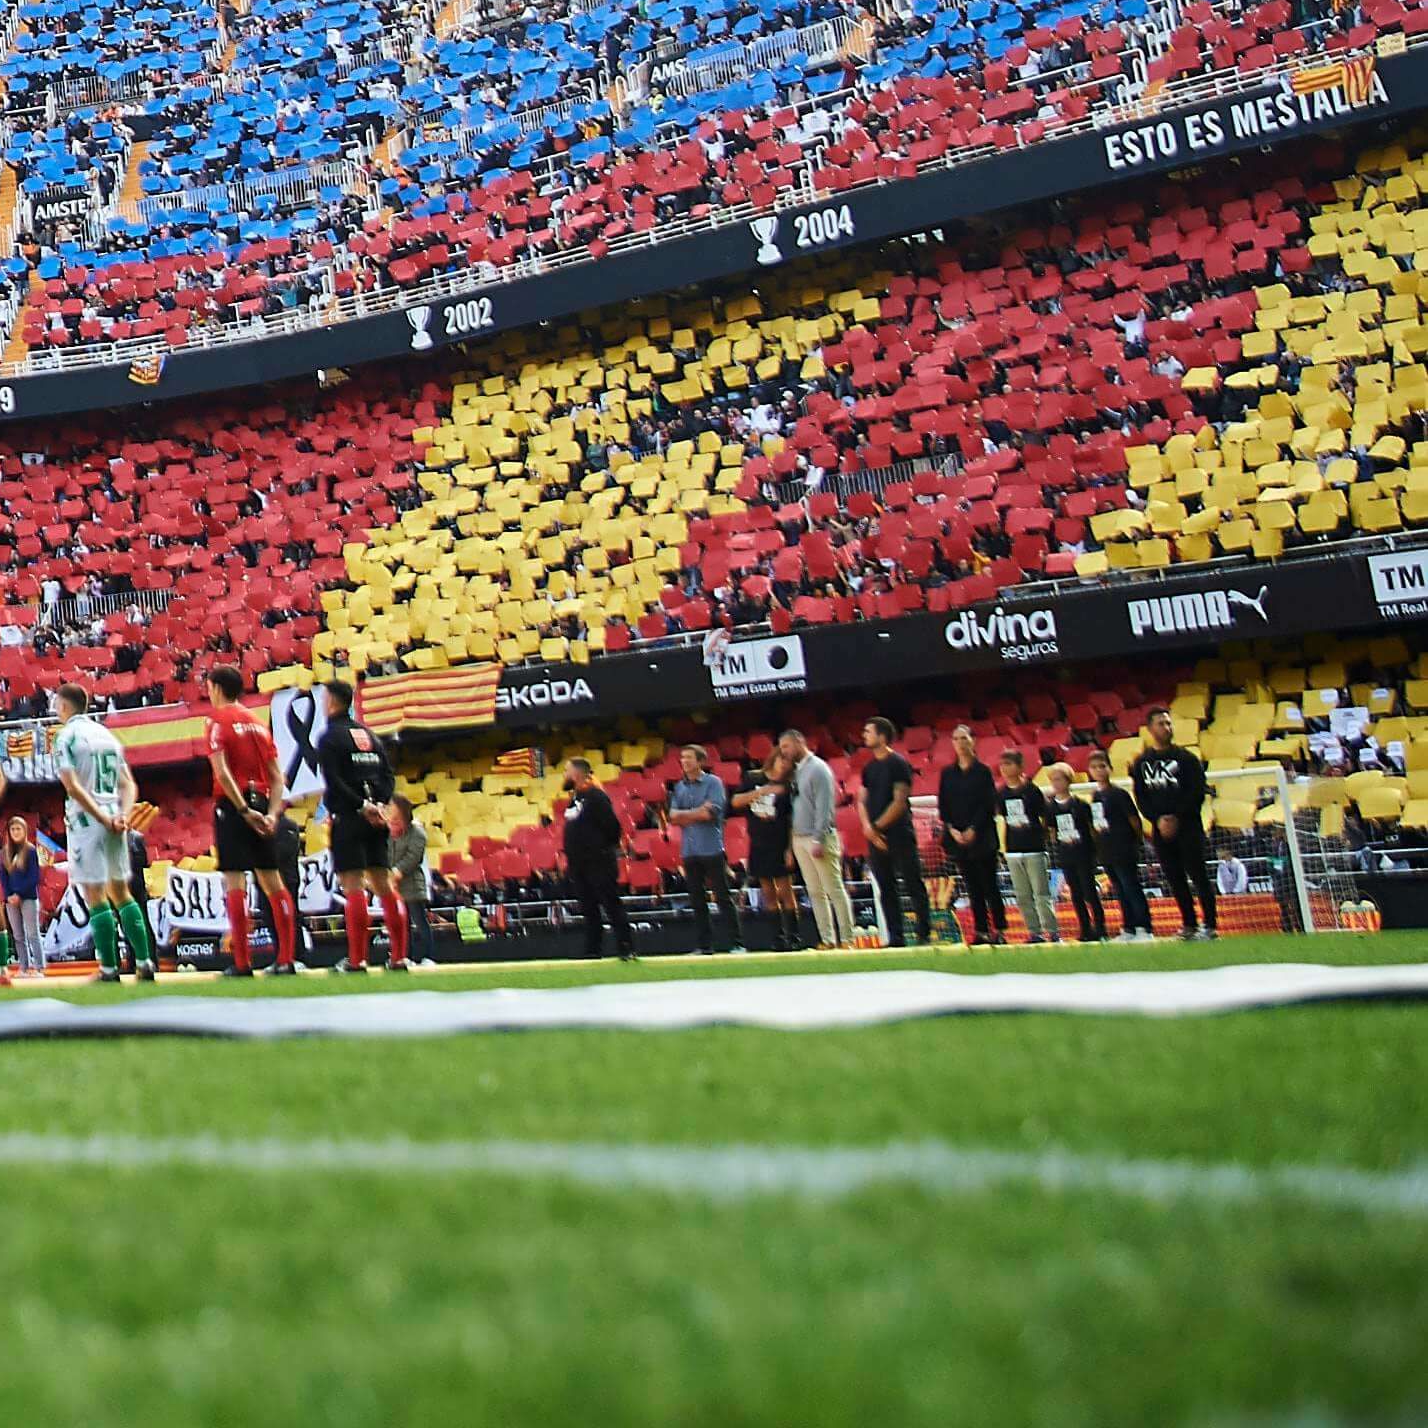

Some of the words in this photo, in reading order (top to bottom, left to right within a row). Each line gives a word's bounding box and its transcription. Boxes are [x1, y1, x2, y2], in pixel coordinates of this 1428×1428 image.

[1104, 122, 1178, 170] ESTO
[1185, 111, 1225, 149] ES
[1230, 71, 1390, 138] MESTALA
[794, 204, 854, 248] 2004
[445, 297, 495, 335] 2002
[1379, 564, 1425, 590] TM
[945, 606, 1057, 649] divina
[1127, 591, 1231, 637] PUMA
[1378, 603, 1399, 617] TM
[1400, 600, 1428, 616] Real
[1001, 640, 1059, 660] seguros
